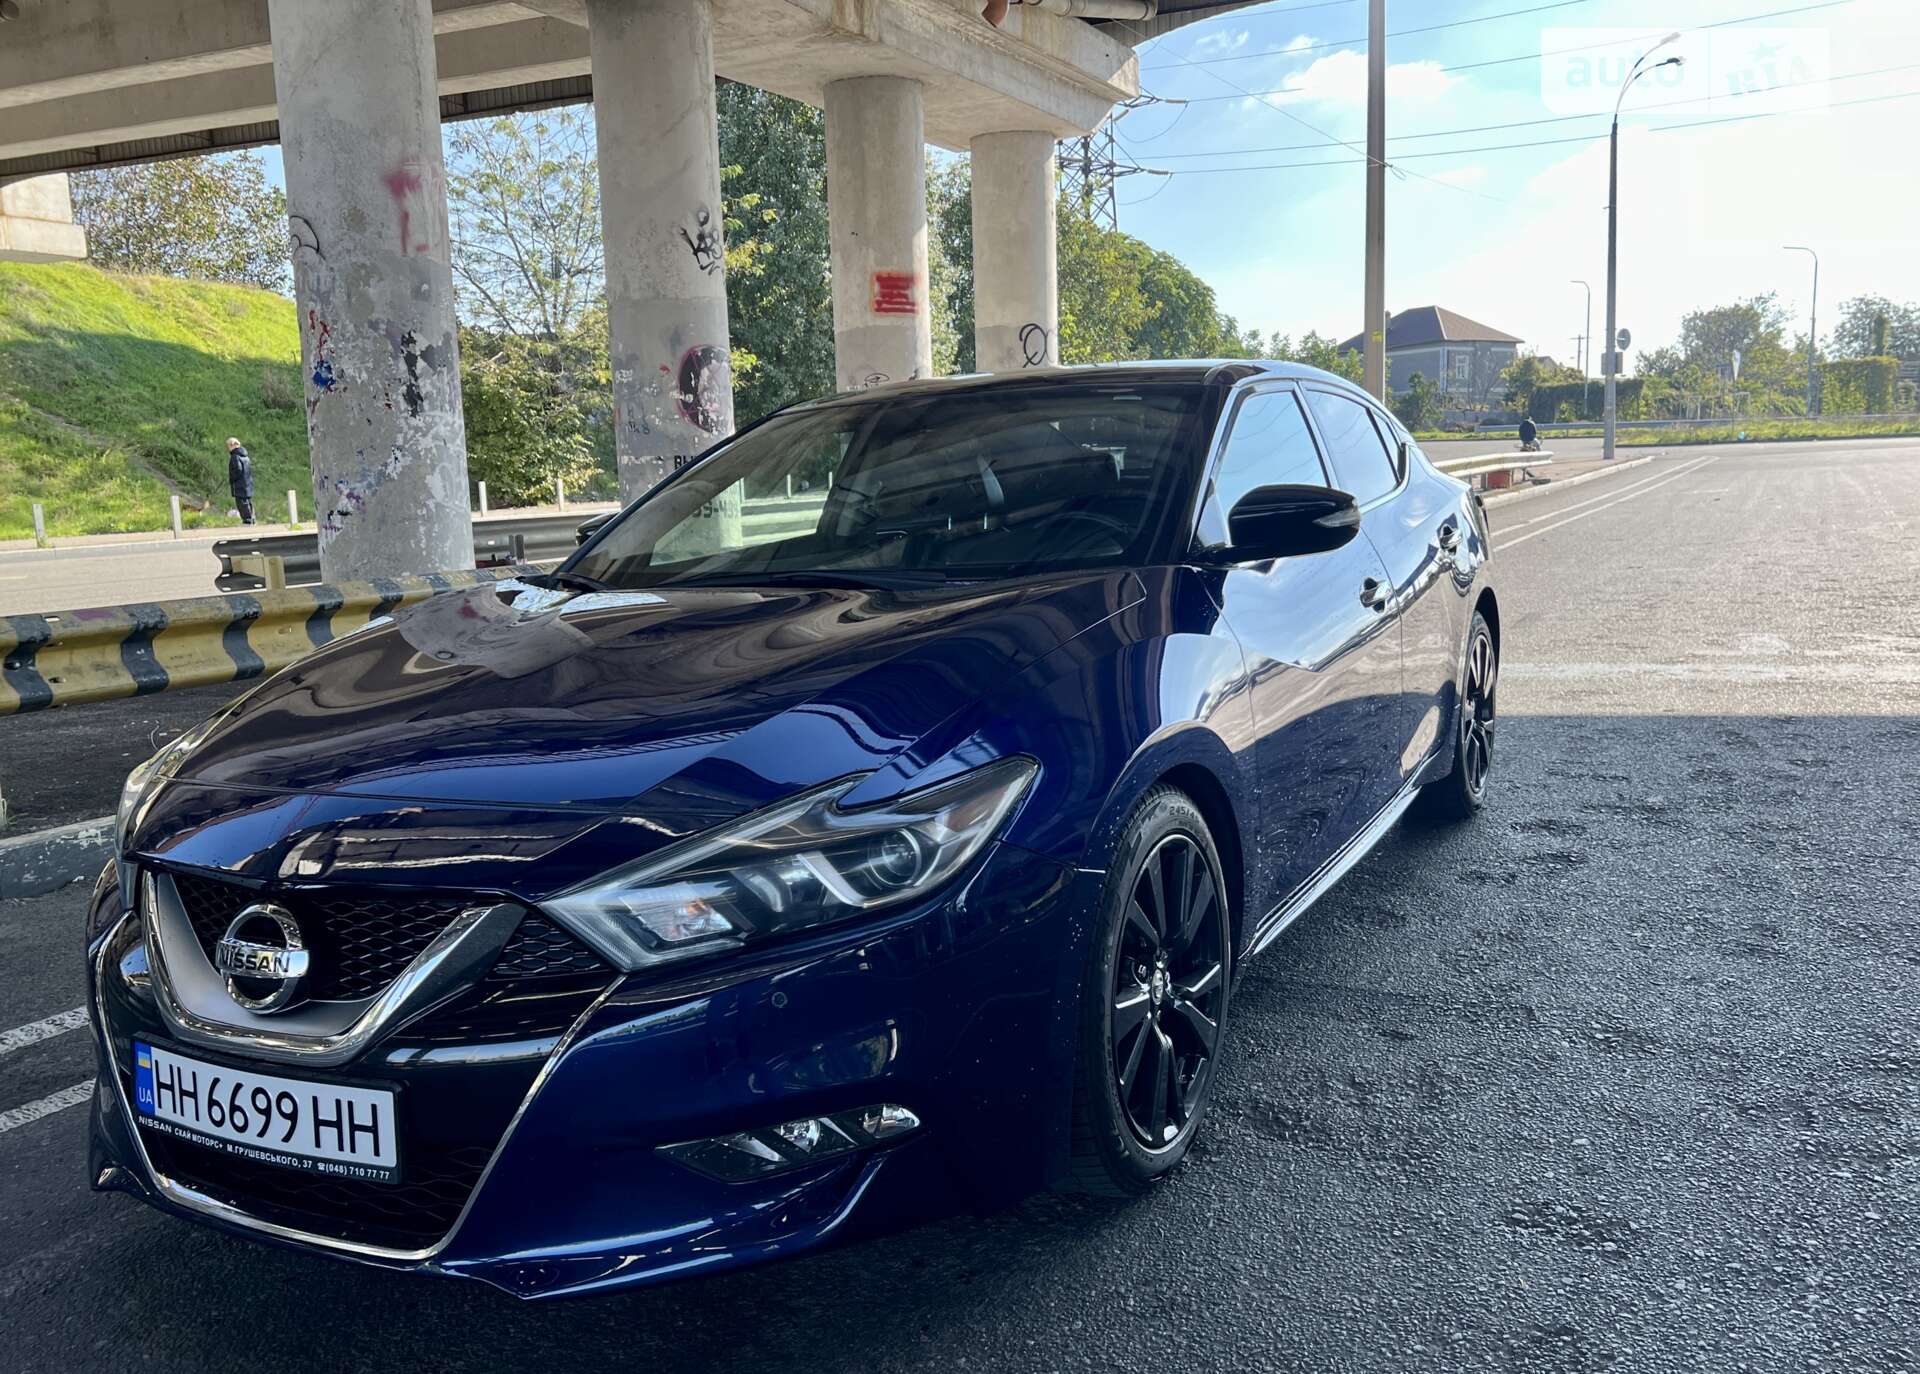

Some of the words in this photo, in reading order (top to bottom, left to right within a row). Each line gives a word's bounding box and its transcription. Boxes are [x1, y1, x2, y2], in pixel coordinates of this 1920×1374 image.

[217, 944, 290, 973] NISSAN
[138, 1086, 153, 1105] UA
[154, 1058, 200, 1122] HH
[207, 1076, 299, 1143] 6699
[312, 1095, 381, 1157] HH
[138, 1115, 172, 1133] NISSAN
[174, 1127, 192, 1140] СКАЙ
[302, 1159, 313, 1169] 37
[349, 1166, 365, 1177] 710
[366, 1169, 378, 1179] 77
[379, 1170, 390, 1180] 77
